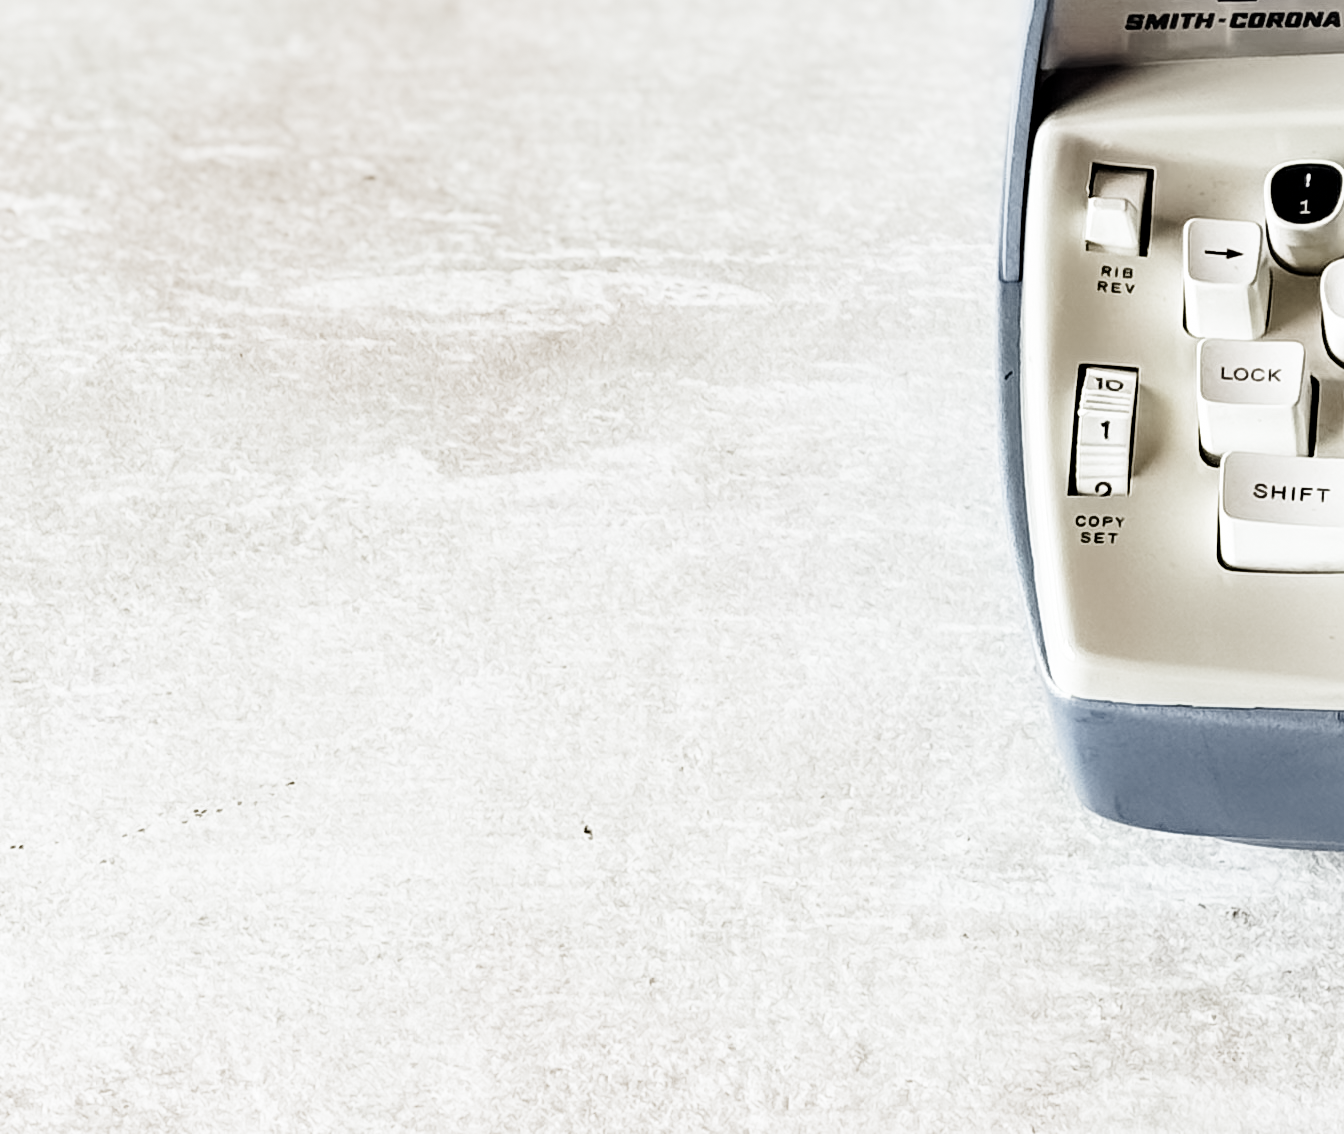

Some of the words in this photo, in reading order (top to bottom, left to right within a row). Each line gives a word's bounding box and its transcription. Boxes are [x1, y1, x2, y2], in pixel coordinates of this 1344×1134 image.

[1124, 11, 1341, 31] SMITH-CORONA
[1299, 199, 1311, 215] 1
[1100, 265, 1133, 279] RIB
[1096, 280, 1136, 294] REV
[1220, 366, 1281, 382] LOCK
[1095, 377, 1124, 392] 10
[1100, 420, 1110, 440] 1
[1253, 483, 1331, 503] SHIFT
[1075, 515, 1124, 528] COPY
[1080, 531, 1118, 544] SET
